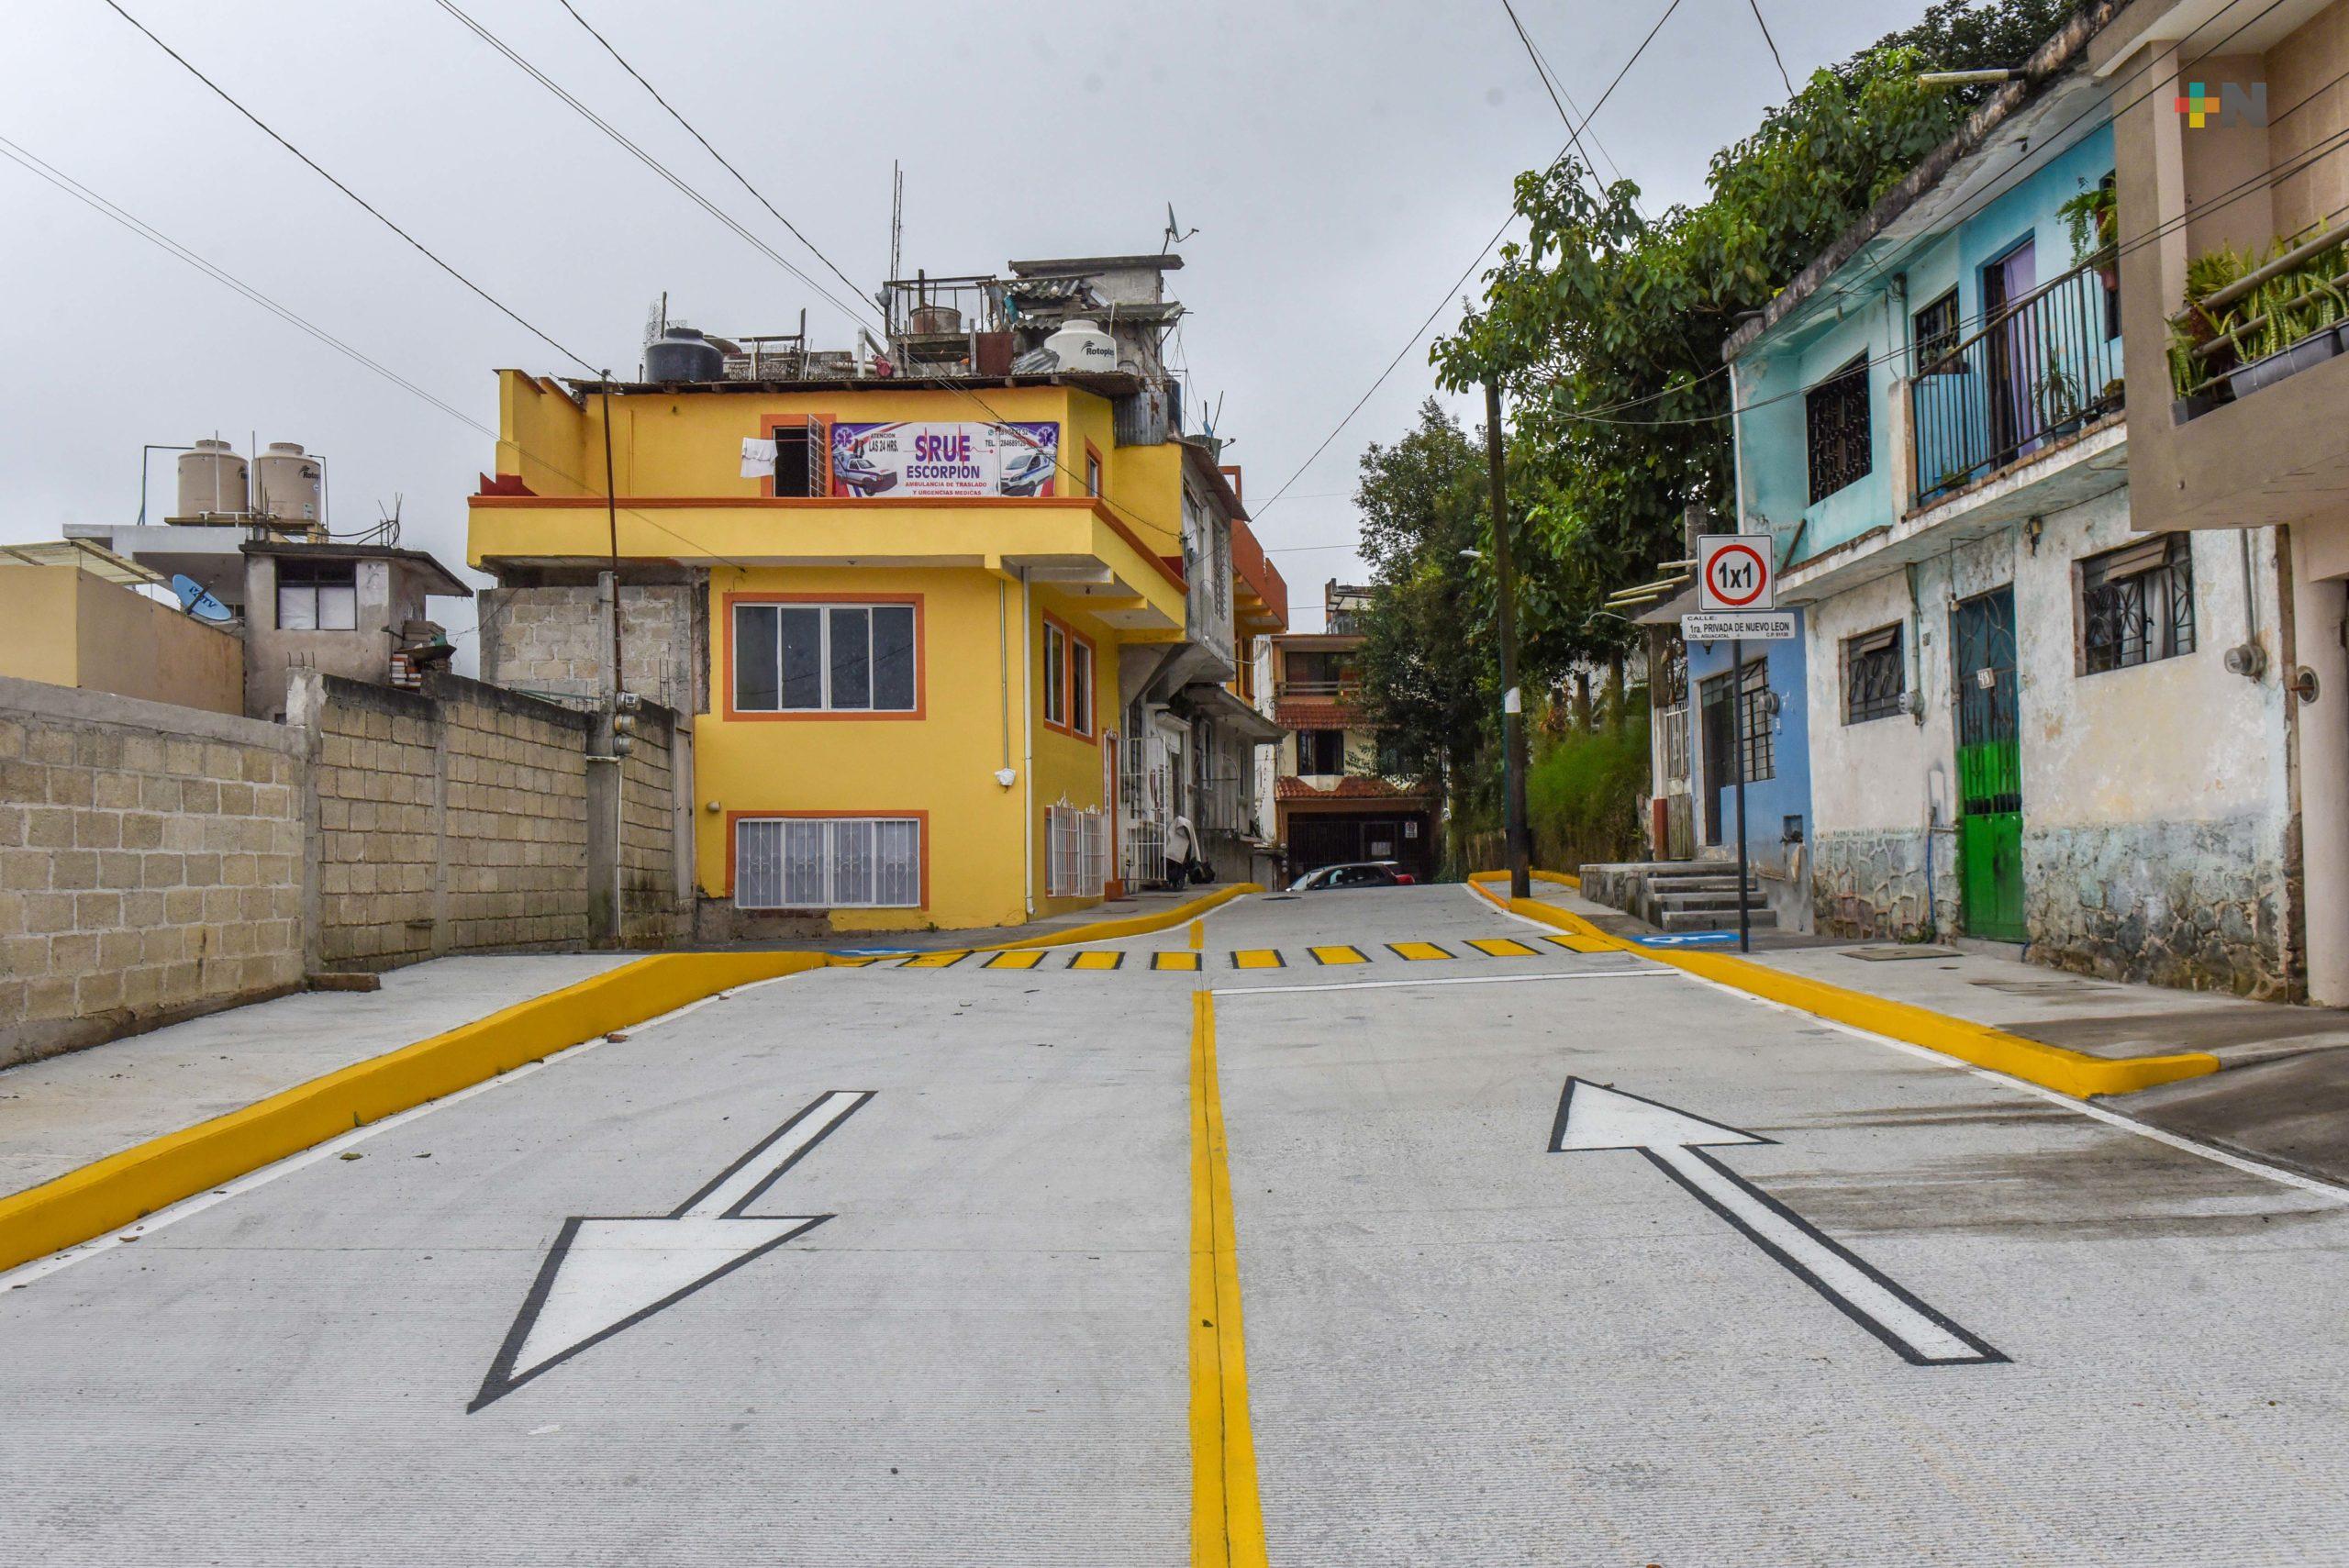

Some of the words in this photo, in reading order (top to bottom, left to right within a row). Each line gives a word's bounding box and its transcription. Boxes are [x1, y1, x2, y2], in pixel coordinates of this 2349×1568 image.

[869, 440, 878, 451] LAS
[879, 440, 885, 451] 24
[915, 435, 971, 462] SRUE
[1719, 562, 1752, 588] 1x1
[1704, 623, 1733, 633] PRIVADA
[1734, 623, 1743, 631] DE
[1746, 622, 1769, 631] NUEVO
[1771, 622, 1790, 631] LEON
